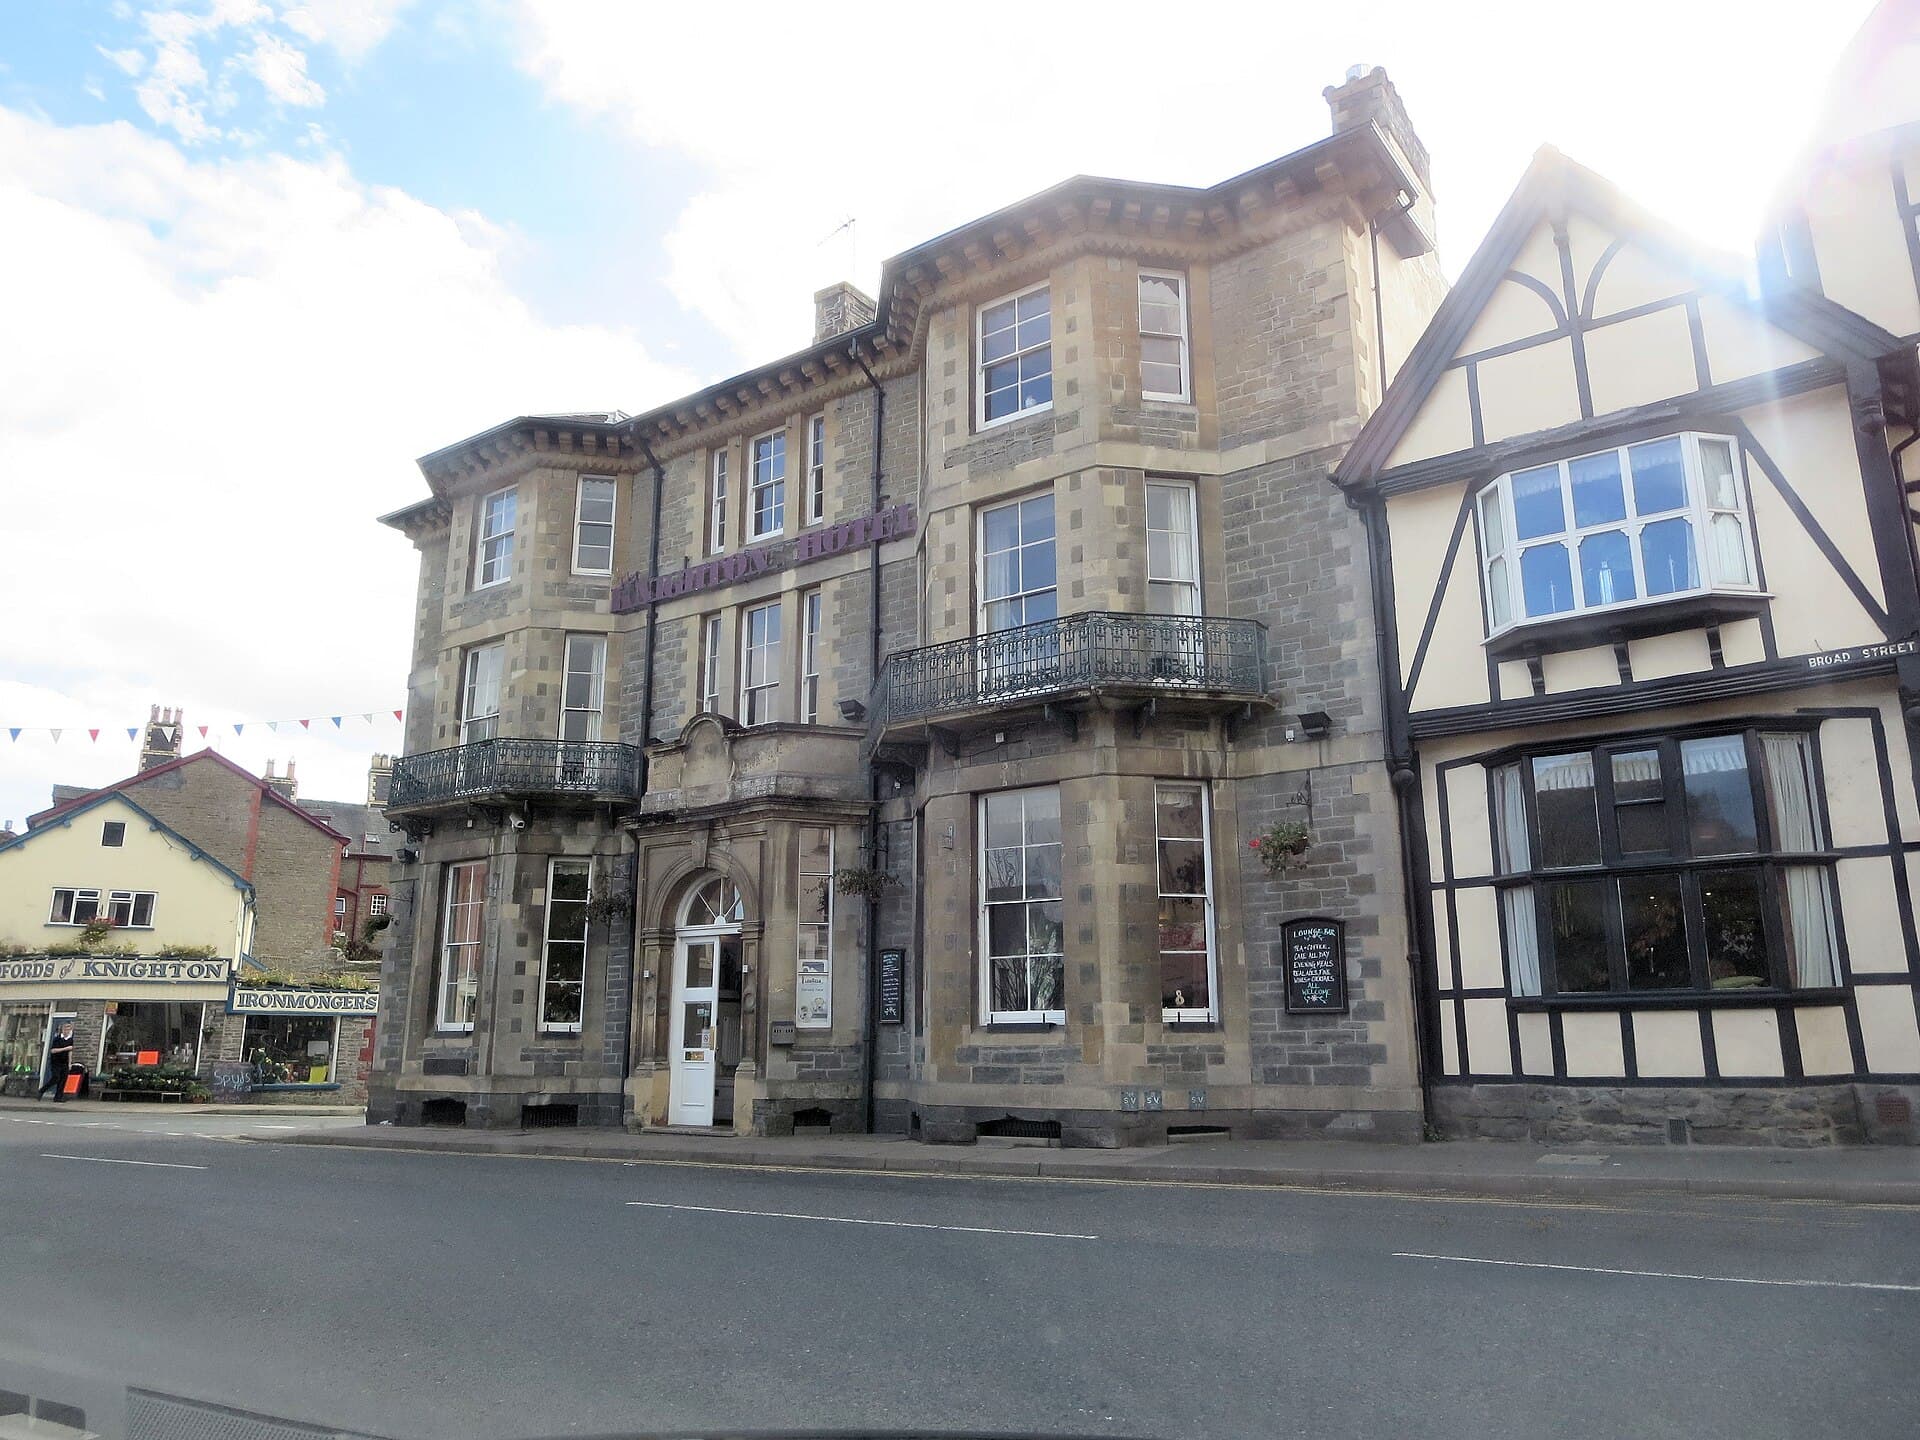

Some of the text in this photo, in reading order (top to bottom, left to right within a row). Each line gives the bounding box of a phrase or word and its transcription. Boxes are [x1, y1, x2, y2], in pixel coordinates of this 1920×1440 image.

[798, 503, 918, 563] HOTEL
[1808, 641, 1916, 668] BROAD STREET
[1293, 928, 1336, 938] LOUNGE BAR
[1319, 951, 1330, 960] DAY
[0, 963, 55, 979] FORDS
[82, 961, 224, 979] KNIGHTON
[237, 993, 379, 1010] IRONMONGERS
[1301, 988, 1332, 998] WELCOME
